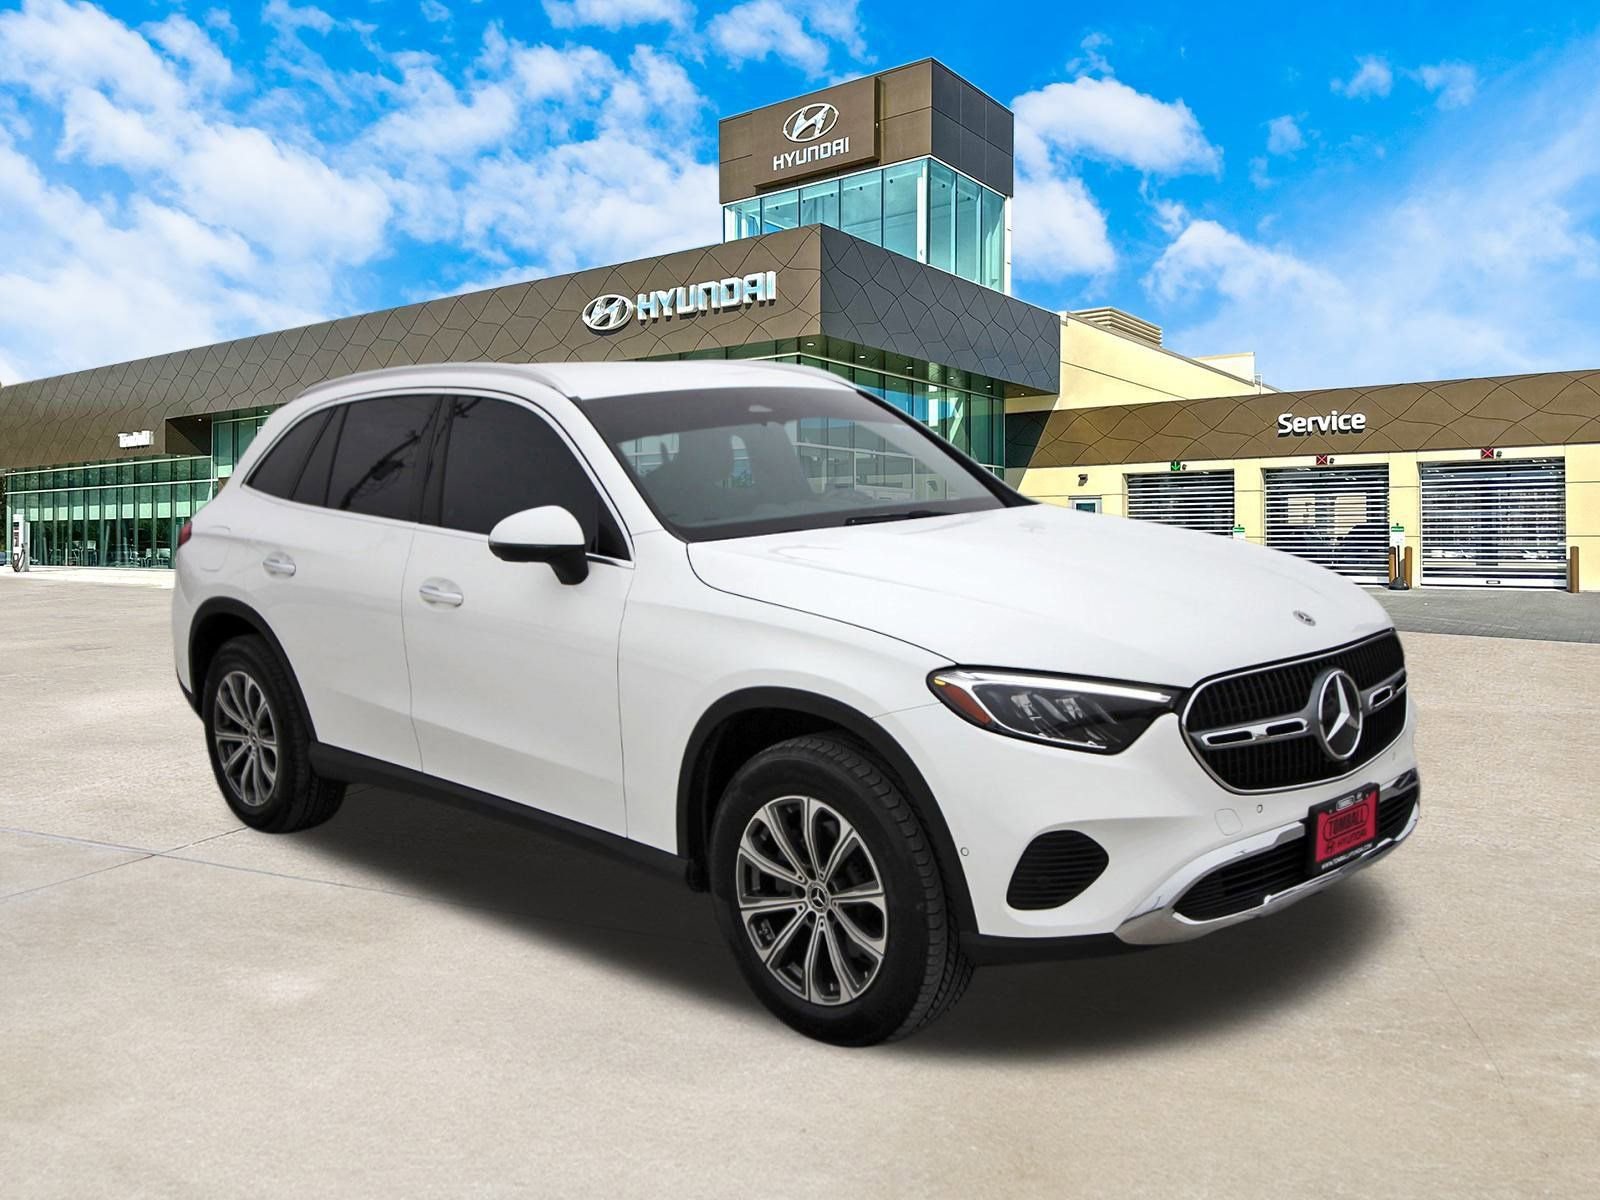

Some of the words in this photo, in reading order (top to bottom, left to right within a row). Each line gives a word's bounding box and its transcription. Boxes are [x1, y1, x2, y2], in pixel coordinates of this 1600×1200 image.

[773, 137, 849, 171] HYUNDAI
[637, 271, 777, 321] HYUNDAI
[1278, 410, 1366, 434] Service
